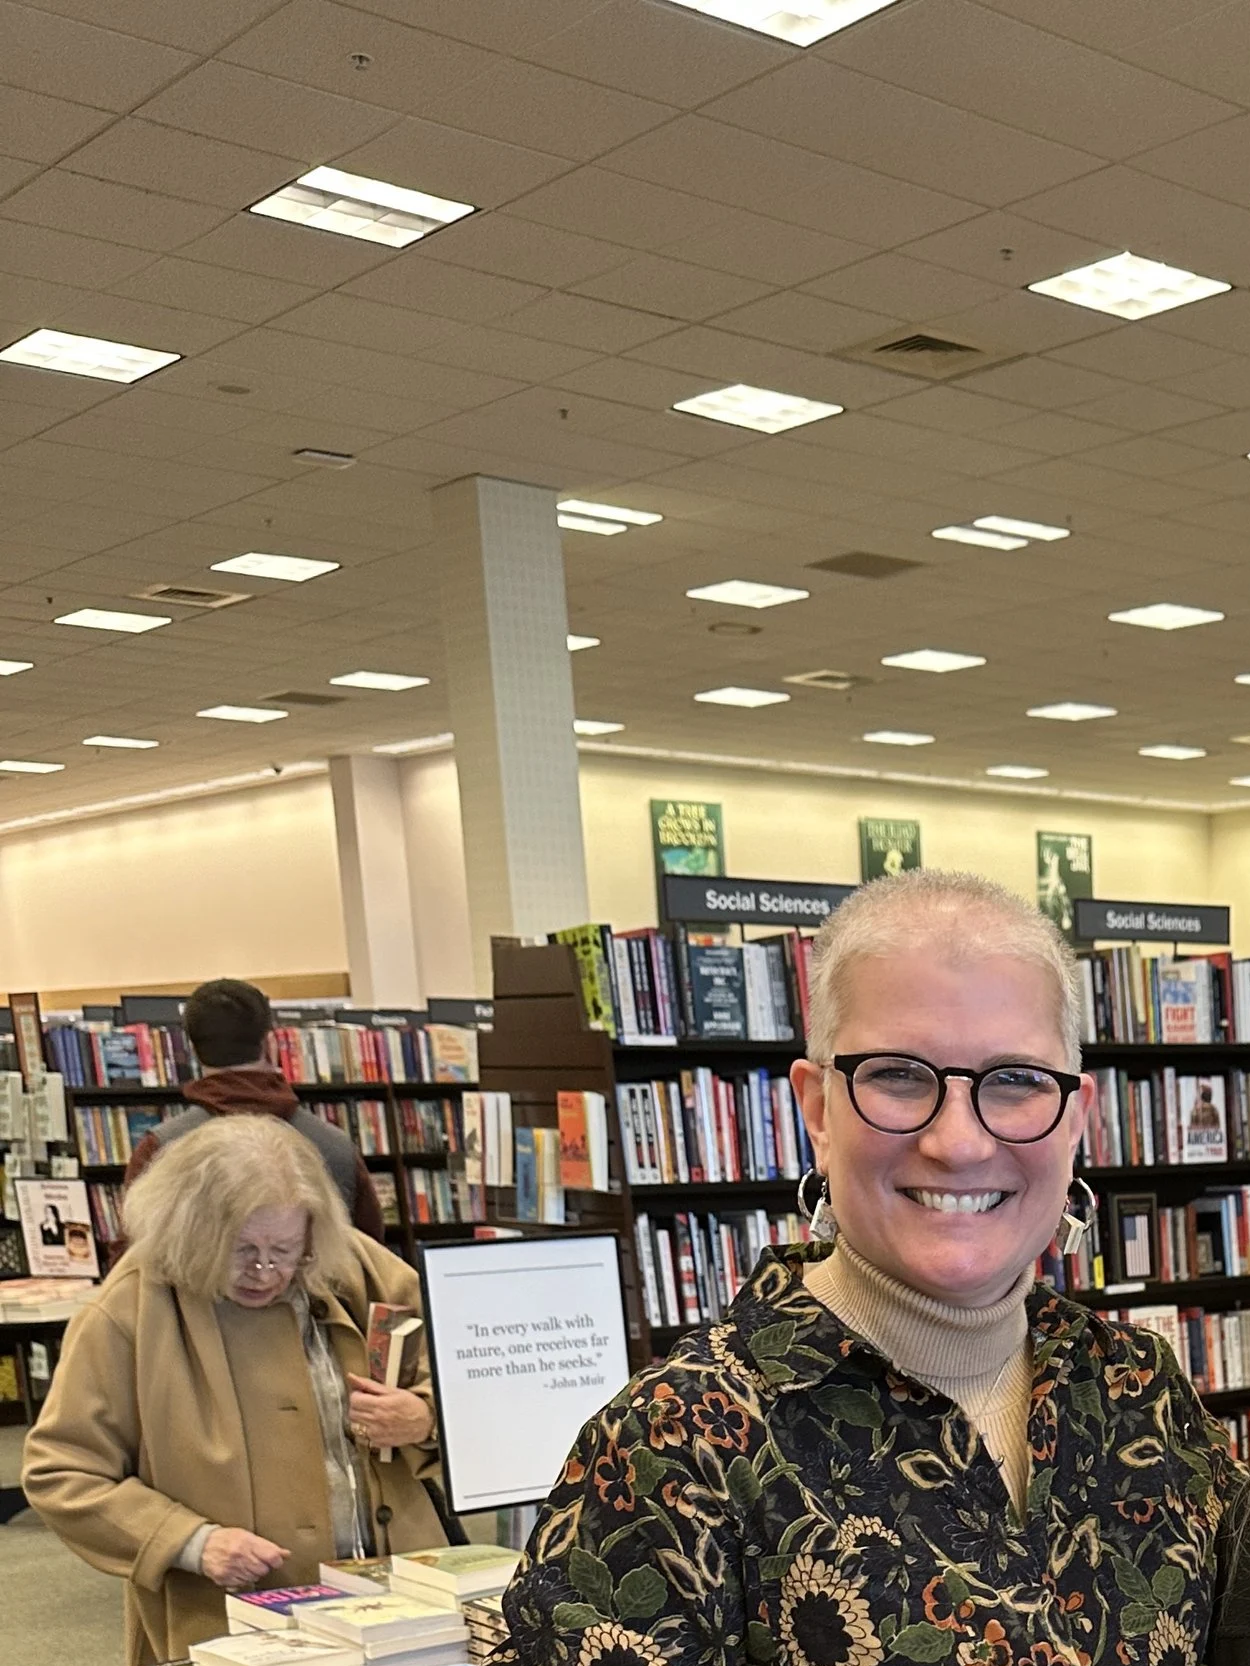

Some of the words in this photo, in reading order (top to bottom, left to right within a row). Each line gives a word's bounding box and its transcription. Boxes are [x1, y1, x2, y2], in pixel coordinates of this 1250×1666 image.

[705, 888, 756, 912] Social
[759, 892, 831, 915] Sciences
[1106, 909, 1145, 929] Social
[1147, 911, 1201, 932] Sciences
[492, 1323, 528, 1336] every
[531, 1316, 563, 1332] walk
[565, 1314, 594, 1329] with
[456, 1343, 505, 1360] nature,
[508, 1342, 533, 1355] one
[536, 1336, 588, 1352] receives
[590, 1333, 609, 1347] far
[467, 1365, 502, 1380] more
[506, 1361, 536, 1375] than
[539, 1357, 556, 1371] he
[580, 1375, 605, 1387] Muir
